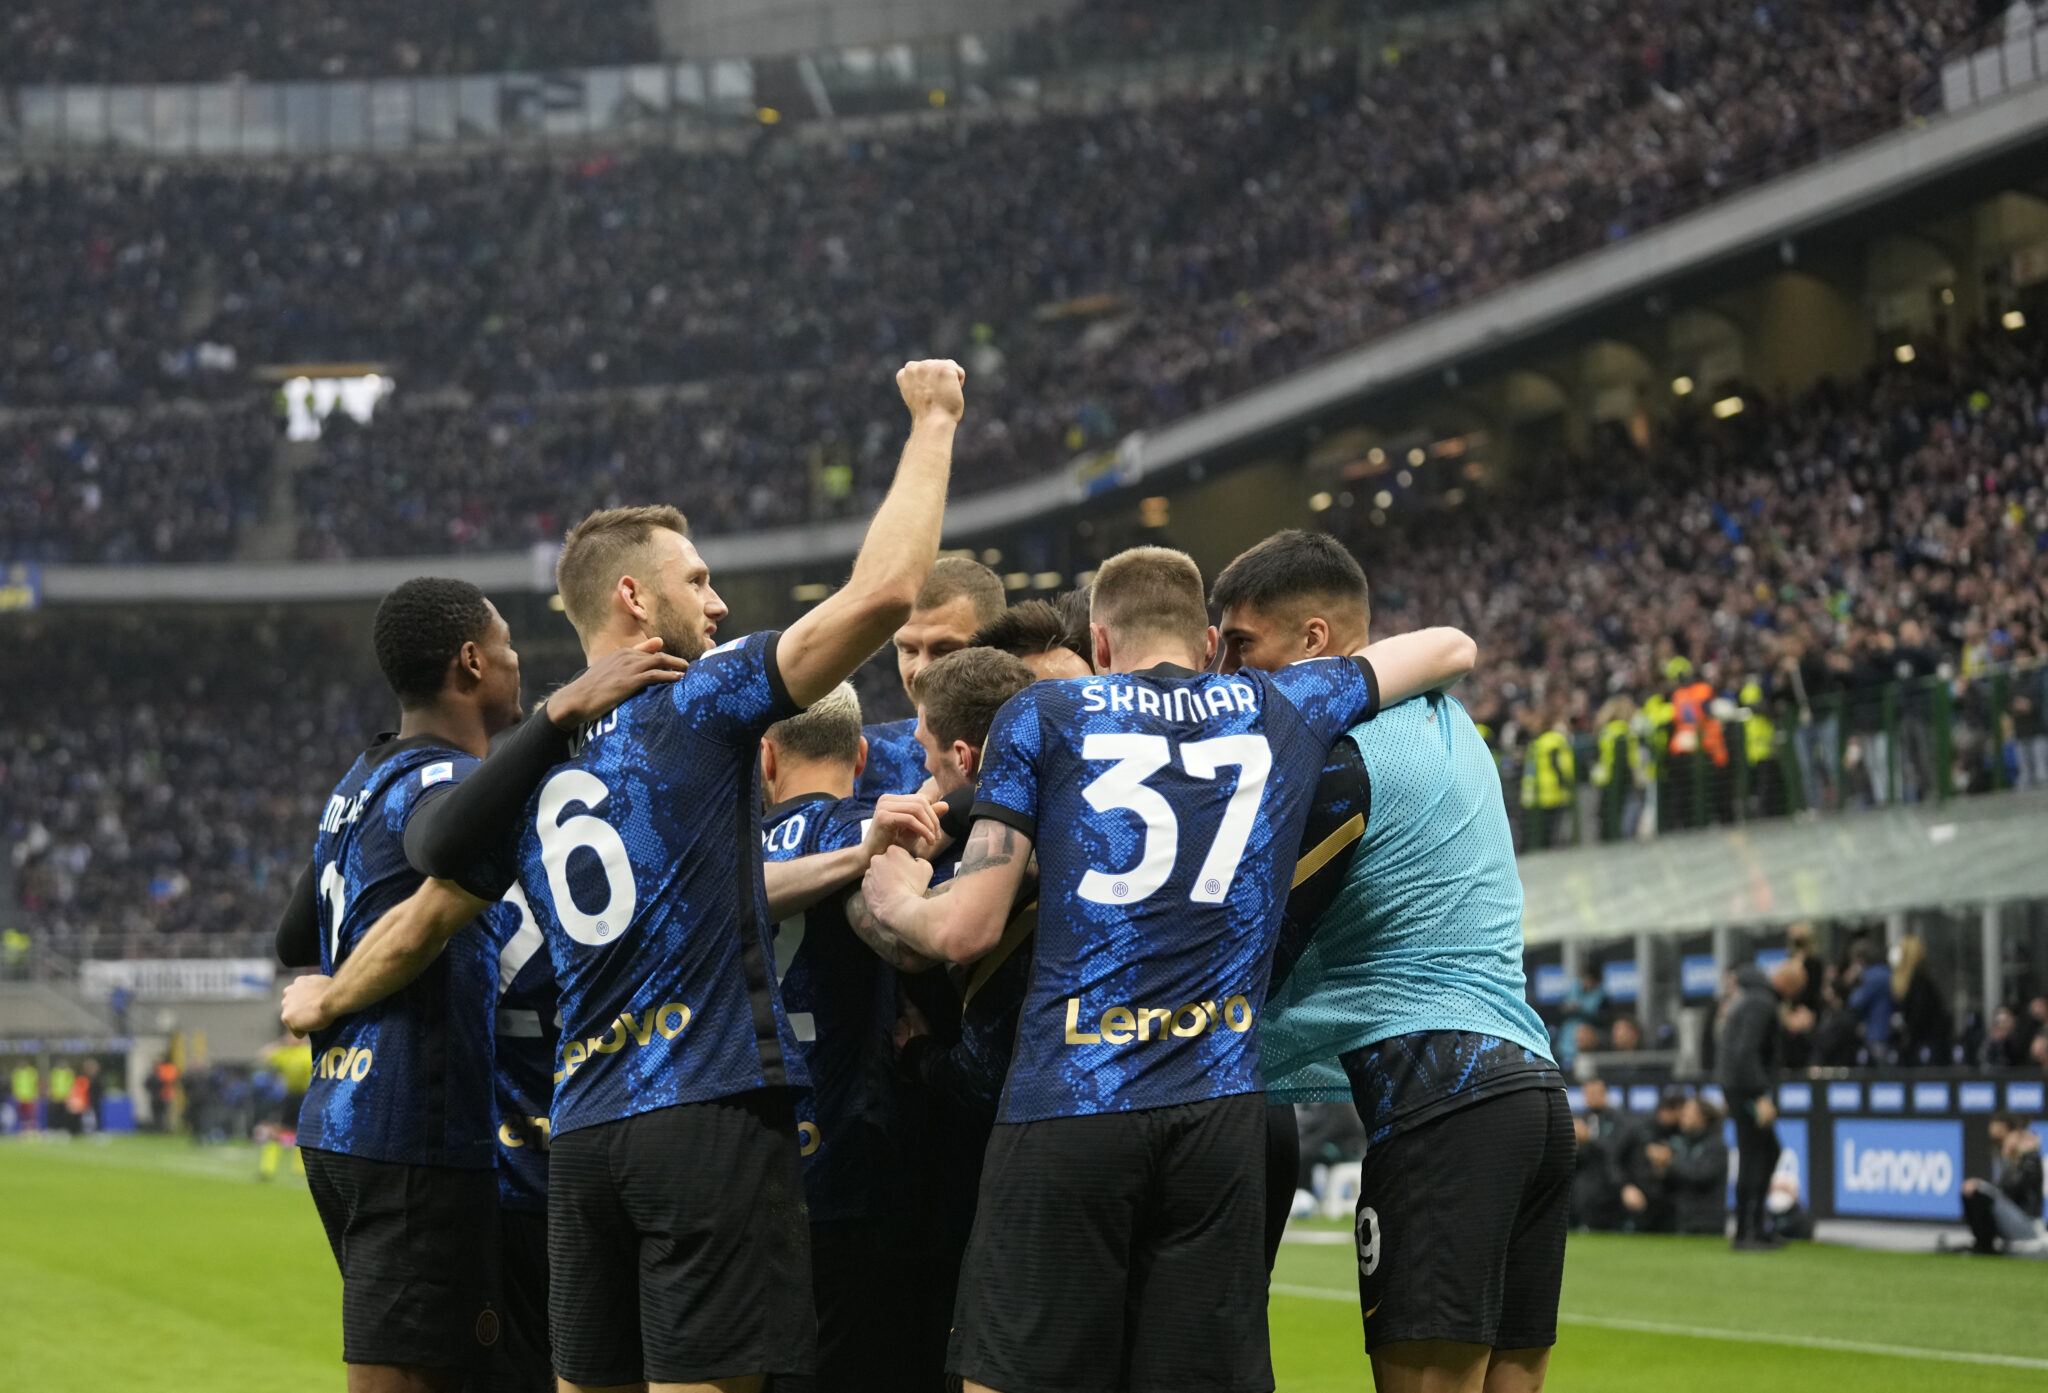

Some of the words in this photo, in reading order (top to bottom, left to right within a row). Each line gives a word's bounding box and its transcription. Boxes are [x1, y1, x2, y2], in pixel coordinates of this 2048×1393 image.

[1082, 680, 1257, 723] ŠKRINIAR
[1077, 733, 1272, 905] 37
[536, 769, 637, 946] 6
[1065, 994, 1253, 1045] Lenovo
[1843, 1138, 1954, 1195] Lenovo
